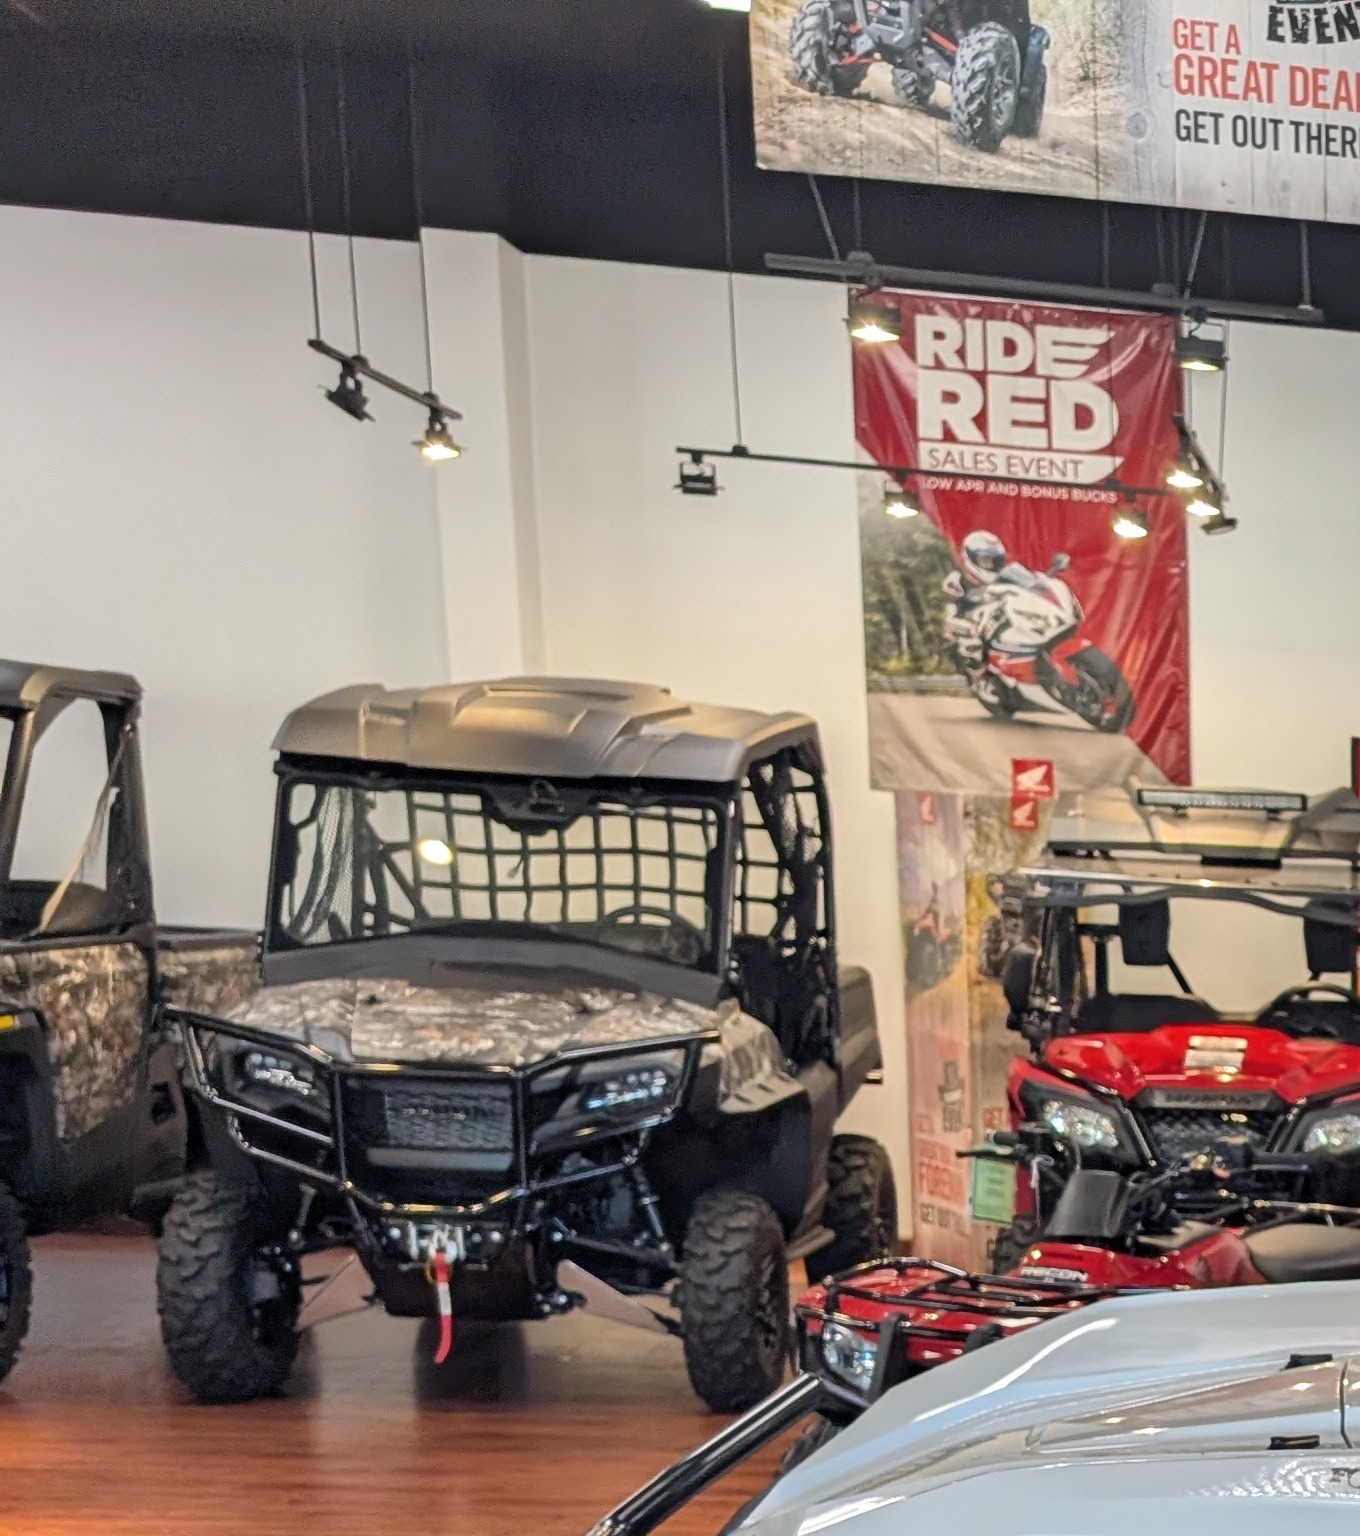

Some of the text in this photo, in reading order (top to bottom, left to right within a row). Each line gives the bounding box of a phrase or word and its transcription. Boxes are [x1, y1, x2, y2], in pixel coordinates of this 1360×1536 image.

[1172, 18, 1242, 55] GET A
[1173, 54, 1278, 104] GREAT
[1174, 110, 1225, 145] GET
[1231, 115, 1285, 152] OUT
[915, 315, 1113, 379] RIDE
[917, 368, 1120, 452] RED
[927, 447, 1086, 481] SALES EVENT
[921, 476, 1118, 504] LOW APR AND BONUS BUCKS
